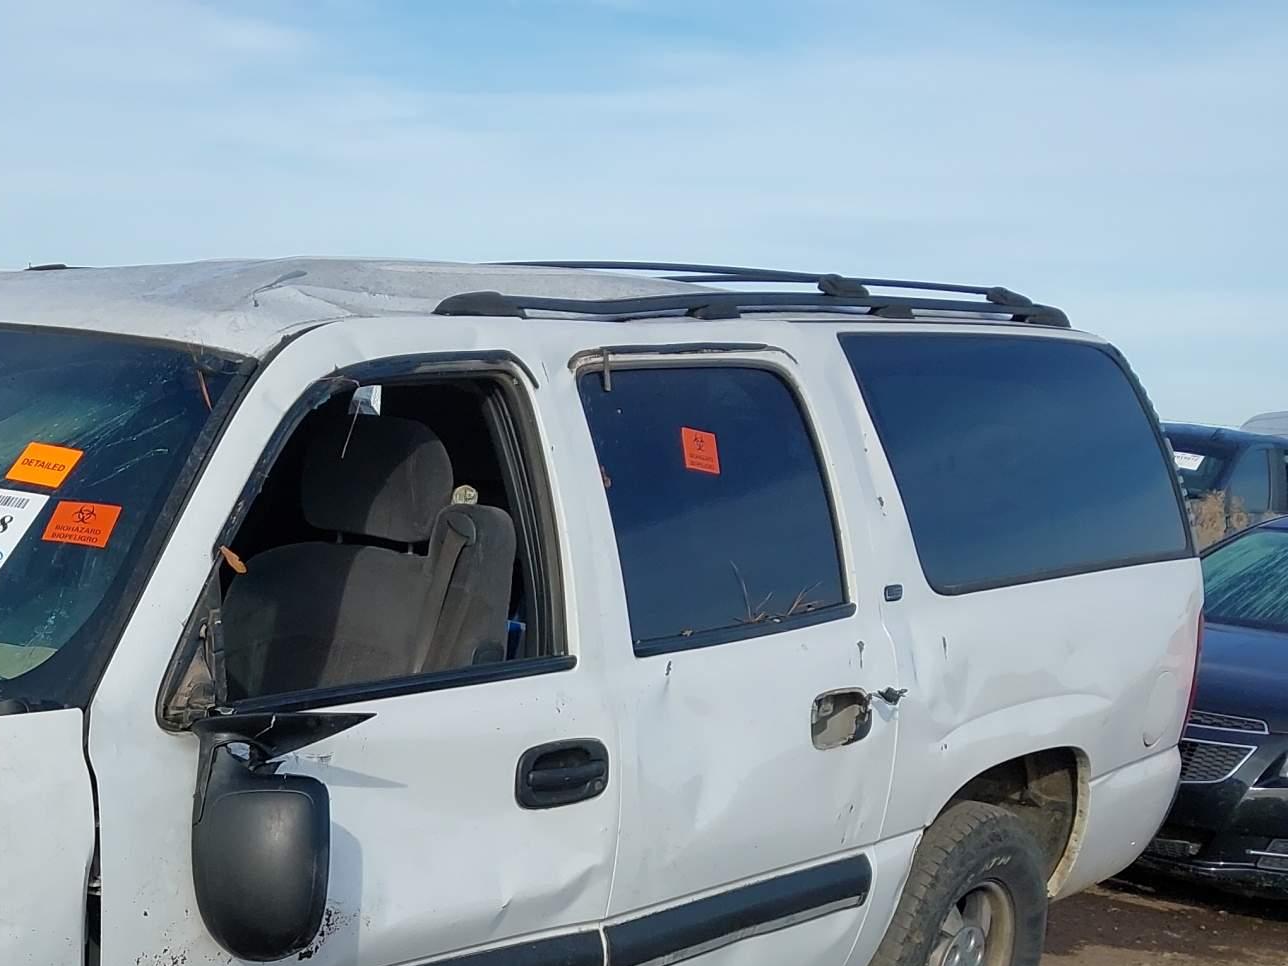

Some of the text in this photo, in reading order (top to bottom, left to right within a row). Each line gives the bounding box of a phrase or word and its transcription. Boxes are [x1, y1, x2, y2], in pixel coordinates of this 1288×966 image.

[21, 458, 66, 472] DETAILED
[55, 524, 101, 536] BIOHAZARD
[52, 532, 98, 544] BIOPELIGRO
